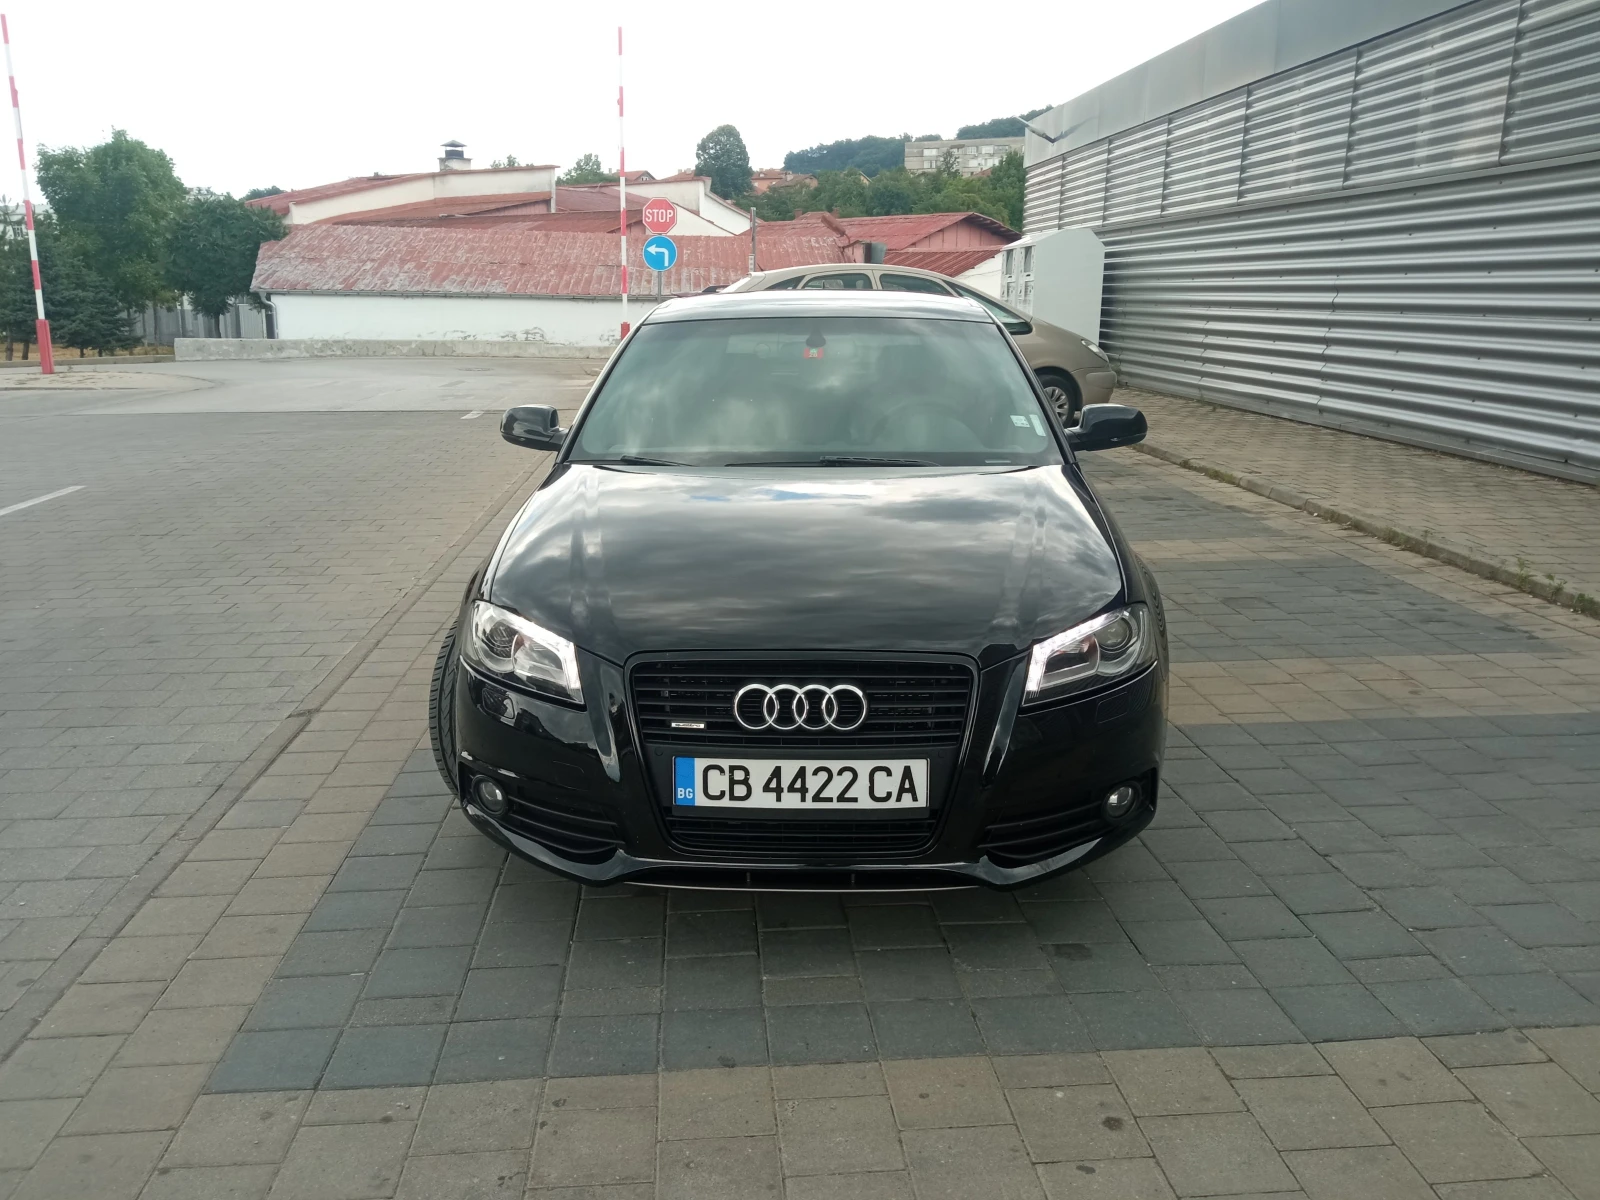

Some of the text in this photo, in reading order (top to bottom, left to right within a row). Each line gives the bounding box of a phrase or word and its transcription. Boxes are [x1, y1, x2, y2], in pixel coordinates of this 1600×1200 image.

[645, 209, 674, 222] STOP
[702, 764, 918, 803] CB 4422 CA
[677, 788, 694, 799] BG
